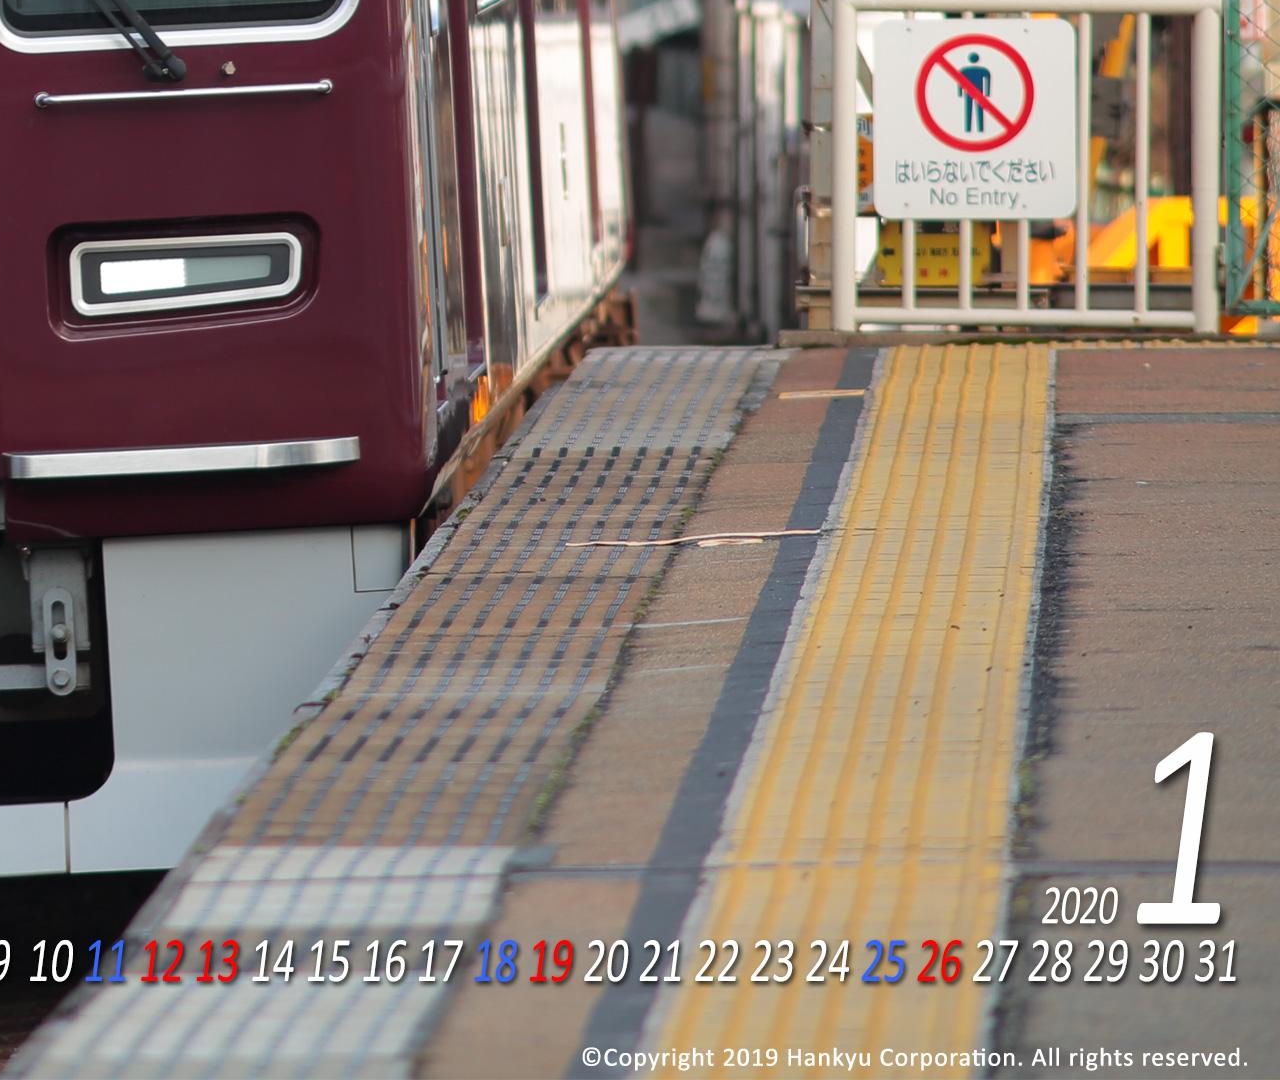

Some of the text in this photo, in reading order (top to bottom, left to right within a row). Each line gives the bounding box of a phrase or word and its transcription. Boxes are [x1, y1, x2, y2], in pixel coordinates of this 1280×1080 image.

[896, 159, 1056, 185] はいらないでください
[930, 188, 1020, 209] No Entry
